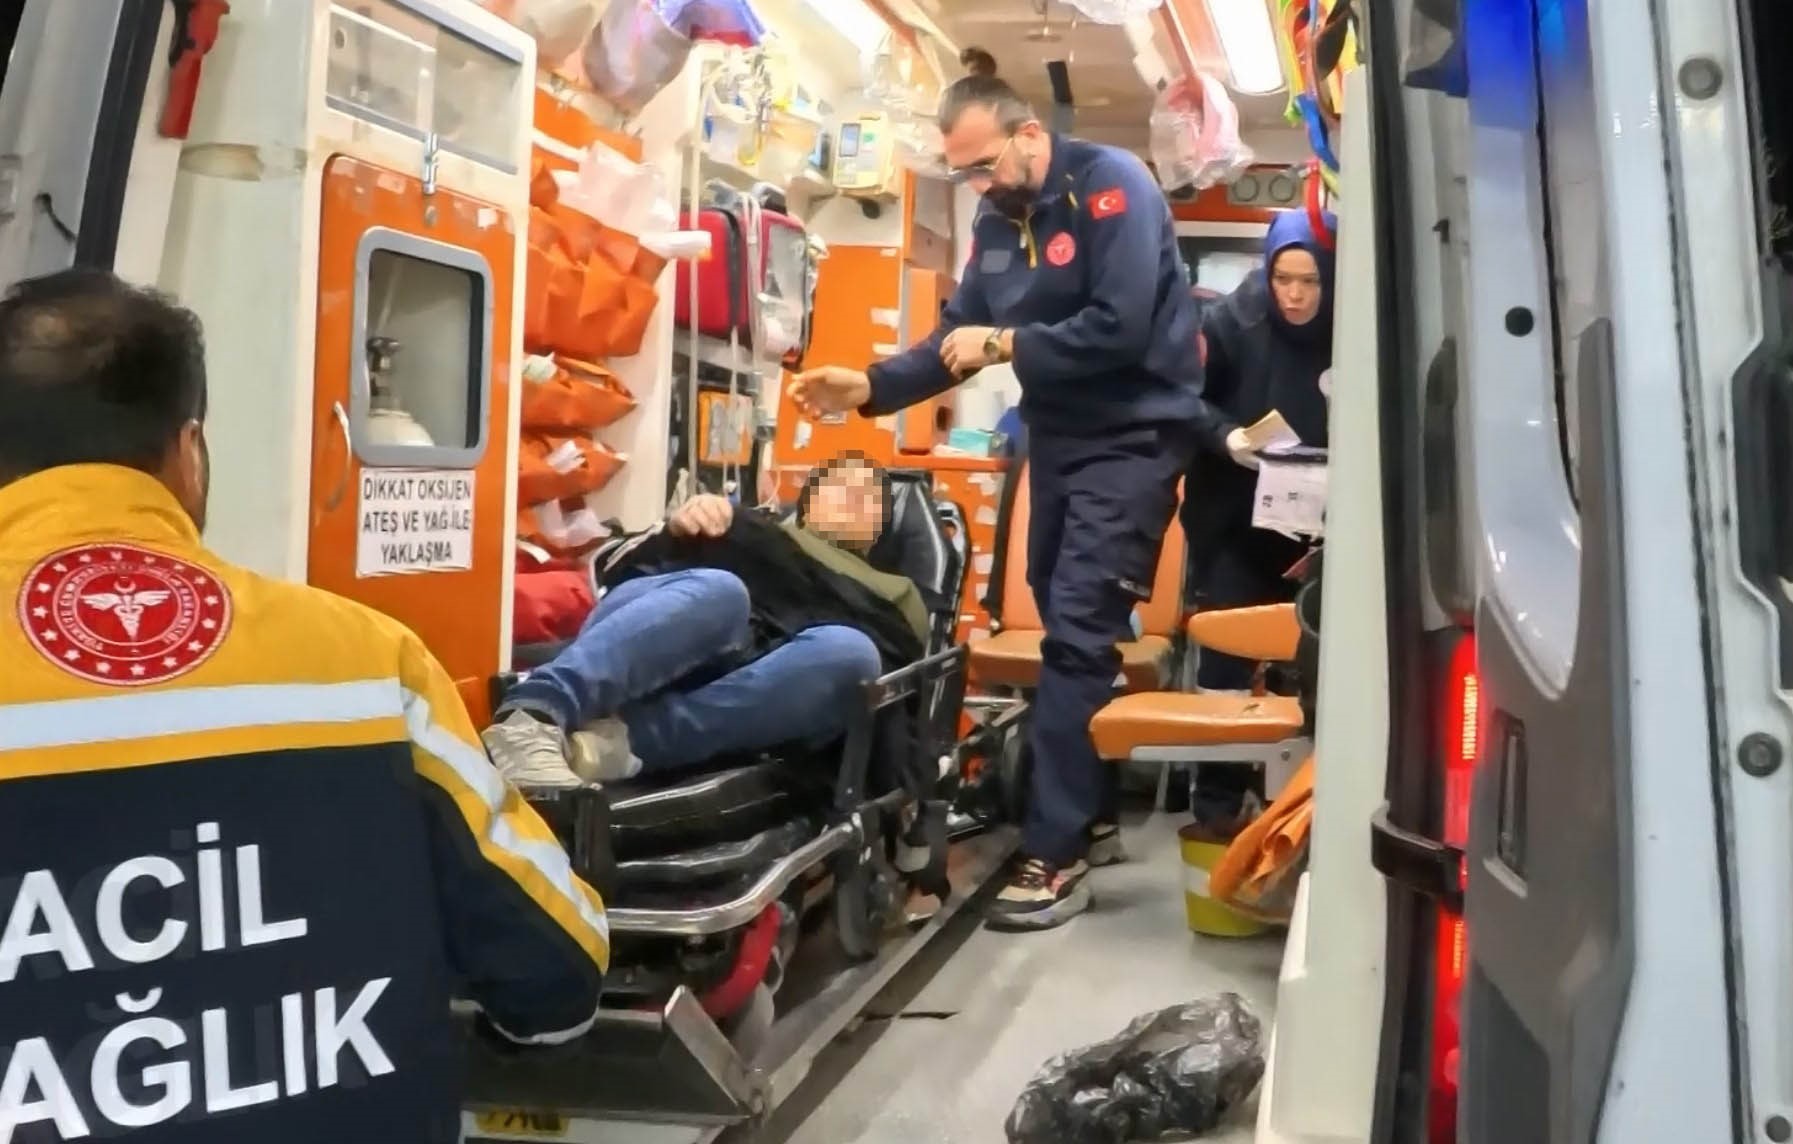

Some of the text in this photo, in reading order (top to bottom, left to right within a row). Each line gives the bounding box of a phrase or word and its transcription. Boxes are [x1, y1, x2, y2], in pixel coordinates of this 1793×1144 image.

[363, 511, 398, 536] ATEŞ
[402, 510, 419, 532] VE
[424, 506, 449, 531] YAĞ
[381, 541, 452, 566] YAKLAŞMA
[0, 822, 307, 982] ACİL
